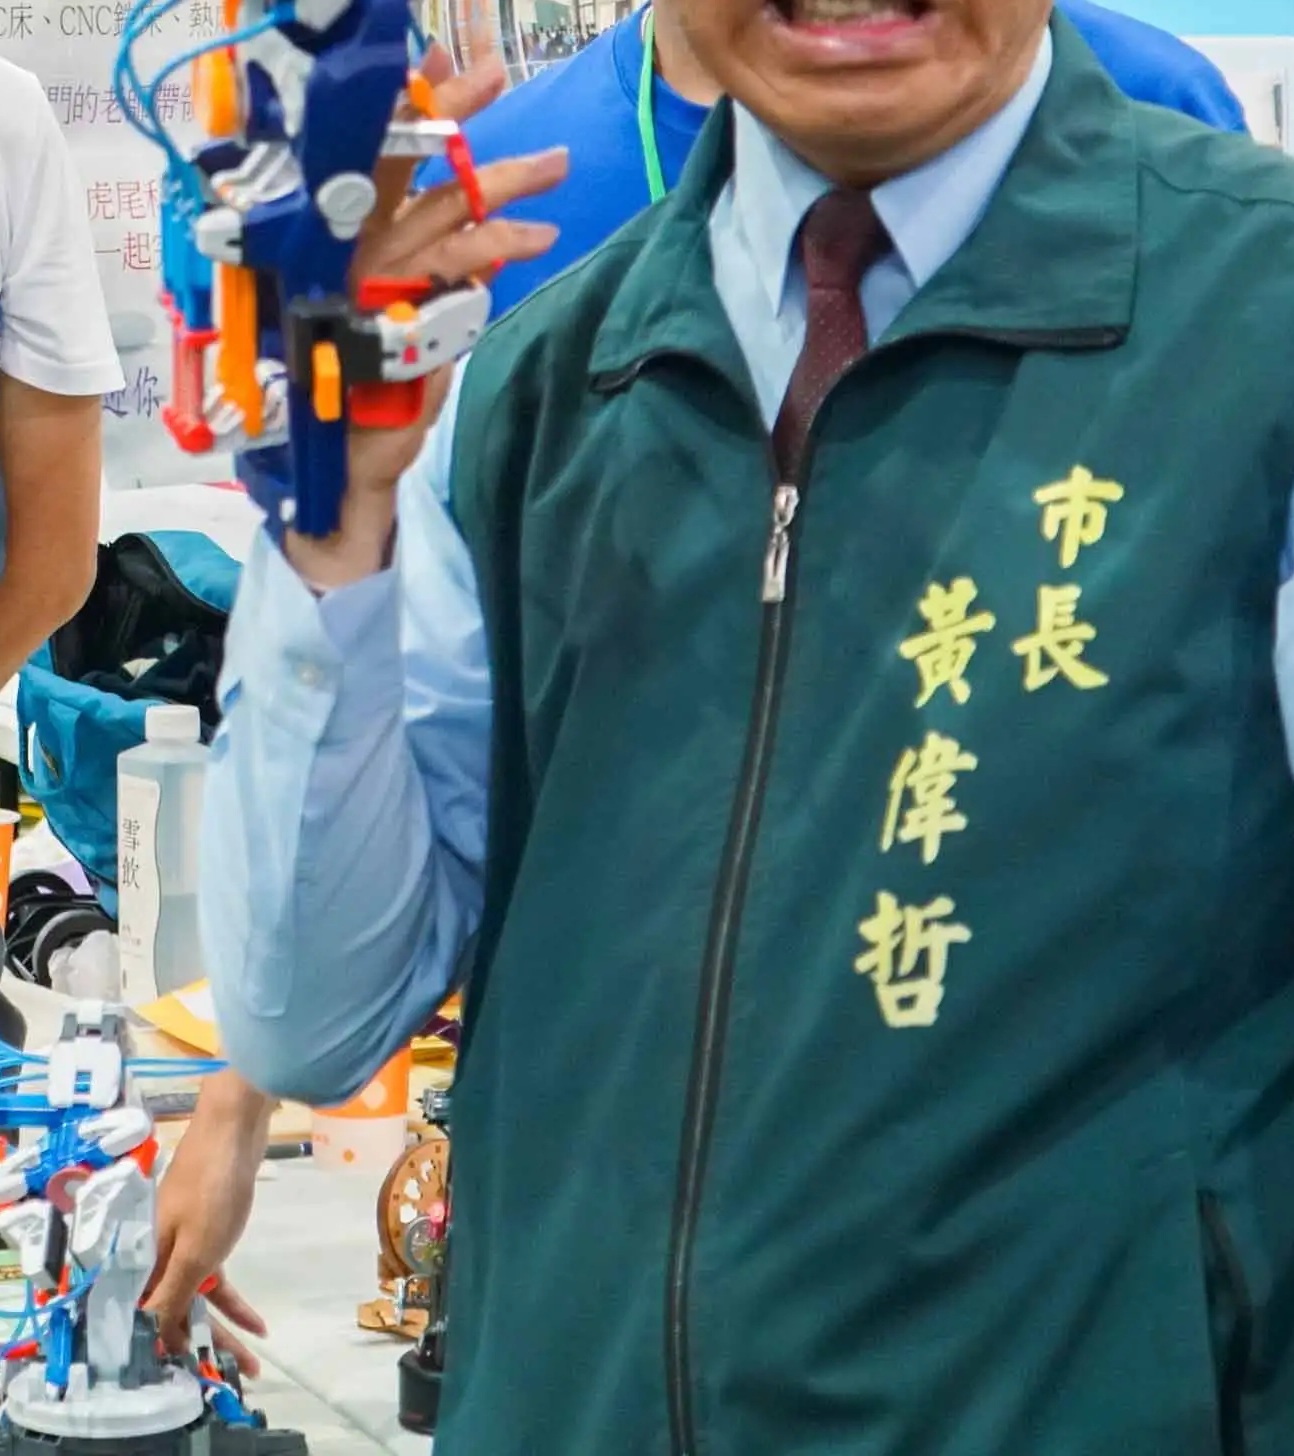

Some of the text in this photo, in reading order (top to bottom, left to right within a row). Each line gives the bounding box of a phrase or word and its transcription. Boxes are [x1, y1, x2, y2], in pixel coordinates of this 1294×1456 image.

[94, 231, 163, 272] 一起
[1011, 463, 1125, 693] 市長
[853, 576, 996, 1030] 黃偉哲
